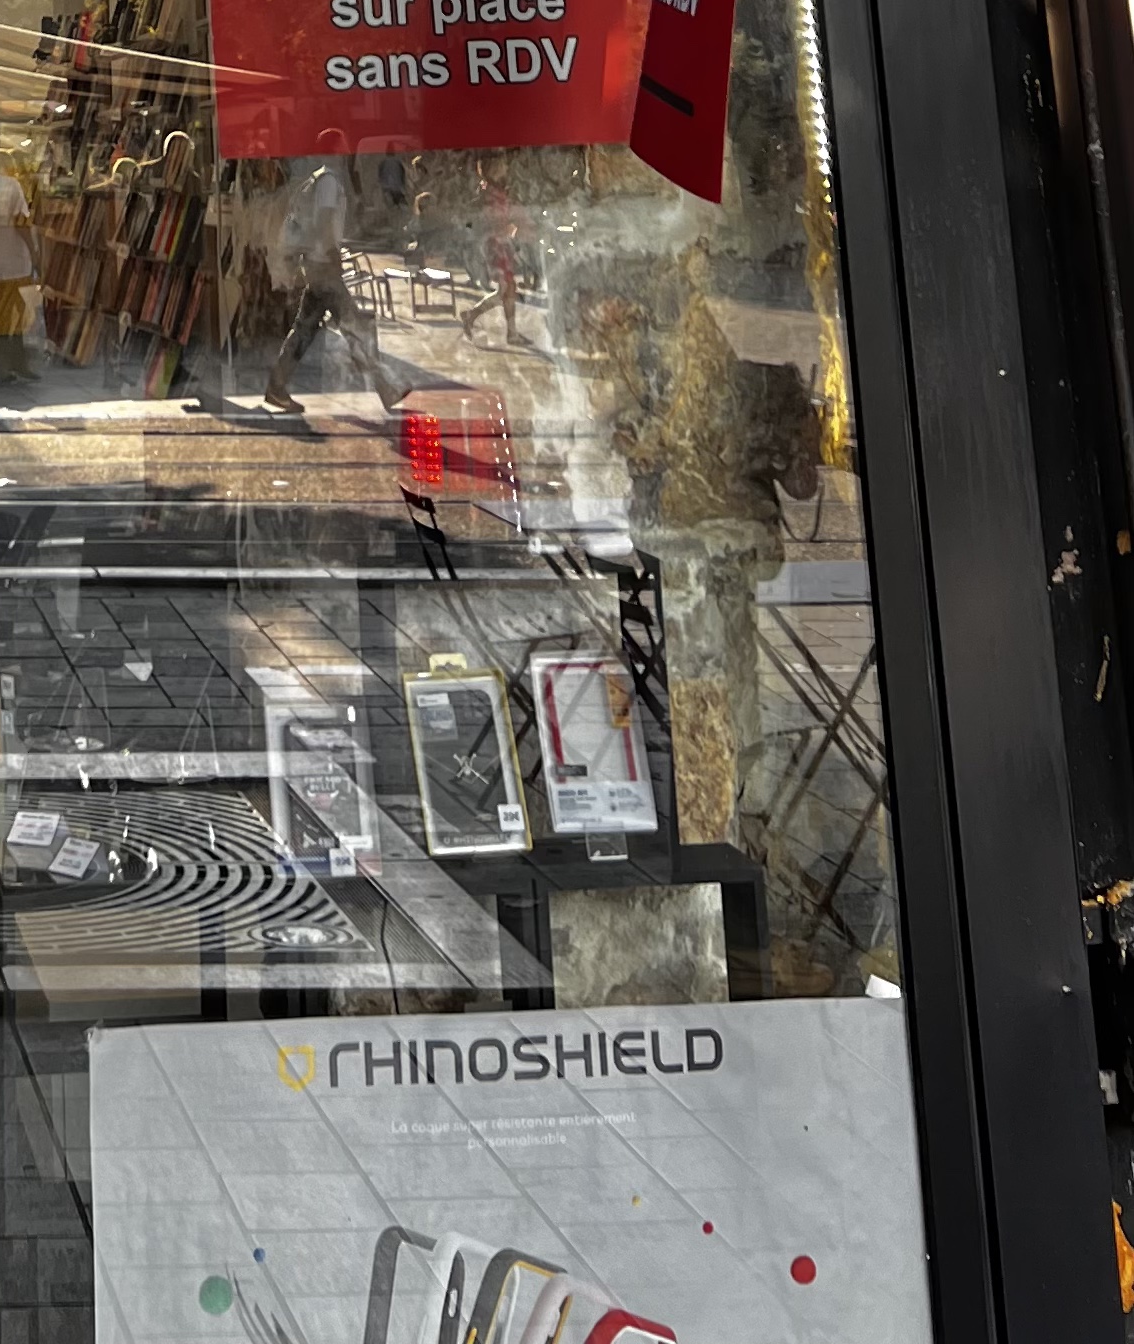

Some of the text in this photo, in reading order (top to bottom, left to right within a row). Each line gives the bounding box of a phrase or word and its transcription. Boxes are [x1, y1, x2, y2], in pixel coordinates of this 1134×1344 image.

[325, 36, 578, 91] sans RDV
[391, 1120, 409, 1134] La
[411, 1121, 450, 1135] coque
